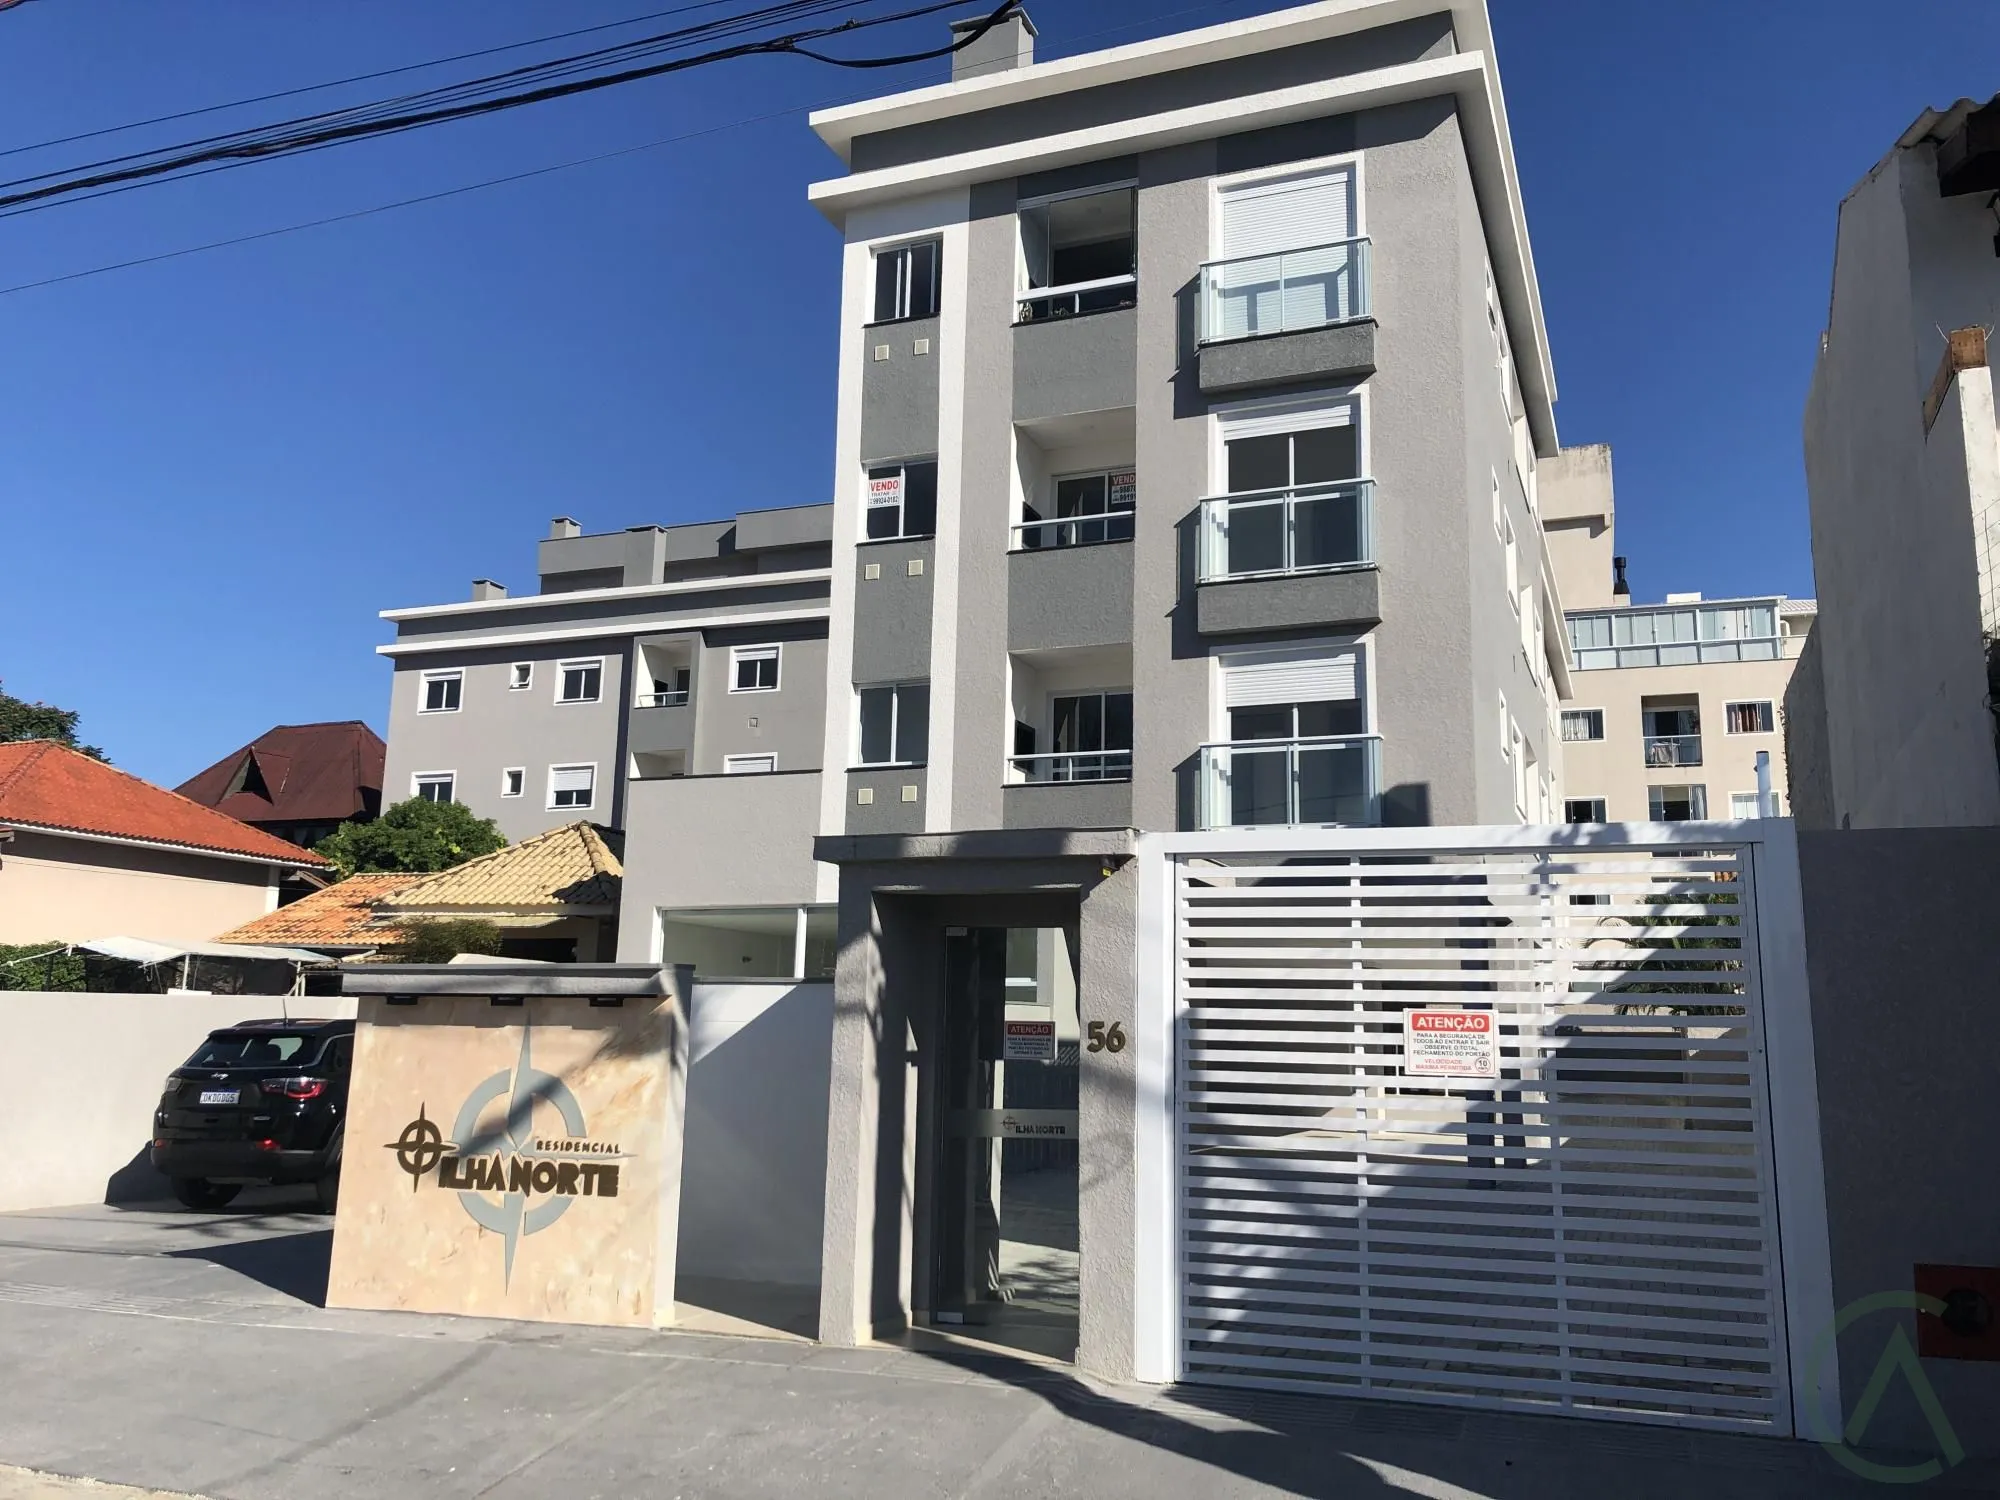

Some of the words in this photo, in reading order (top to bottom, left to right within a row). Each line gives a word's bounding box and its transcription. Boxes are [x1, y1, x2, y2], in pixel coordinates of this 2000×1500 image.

[870, 480, 898, 491] VENDO
[1112, 474, 1135, 484] VEND
[1416, 1016, 1485, 1030] ATENÇÃO
[1086, 1020, 1126, 1053] 56
[536, 1140, 621, 1154] RESIDENCIAL
[509, 1152, 620, 1198] NORTE
